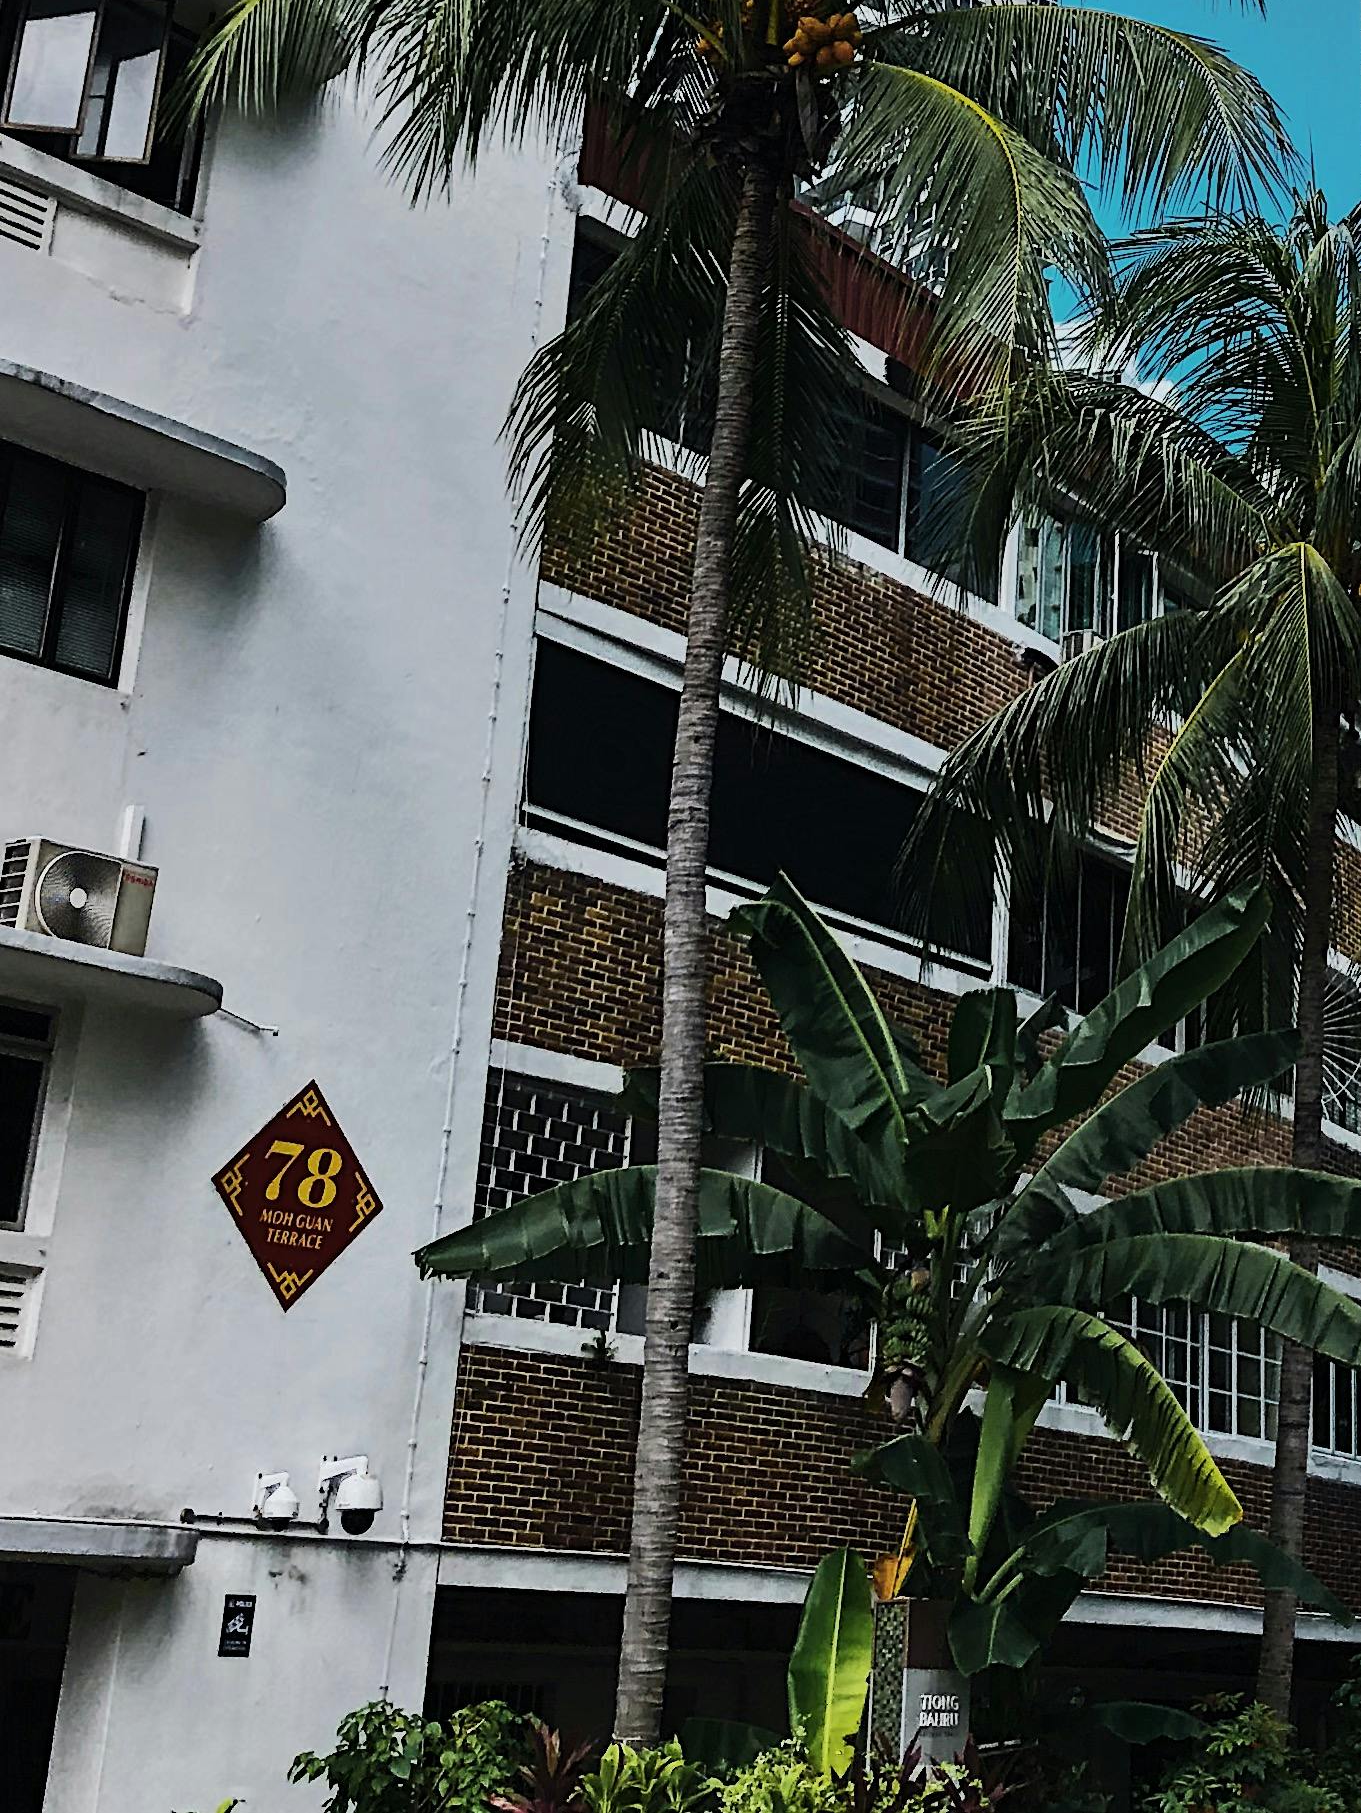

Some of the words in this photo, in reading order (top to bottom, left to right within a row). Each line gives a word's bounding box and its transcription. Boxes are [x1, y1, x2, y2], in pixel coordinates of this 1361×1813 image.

[264, 1140, 342, 1208] 78
[260, 1209, 293, 1227] MOH
[296, 1214, 334, 1232] GUAN
[266, 1228, 324, 1250] TERRACE
[920, 1694, 959, 1710] TIONG
[920, 1712, 959, 1727] BAHRU
